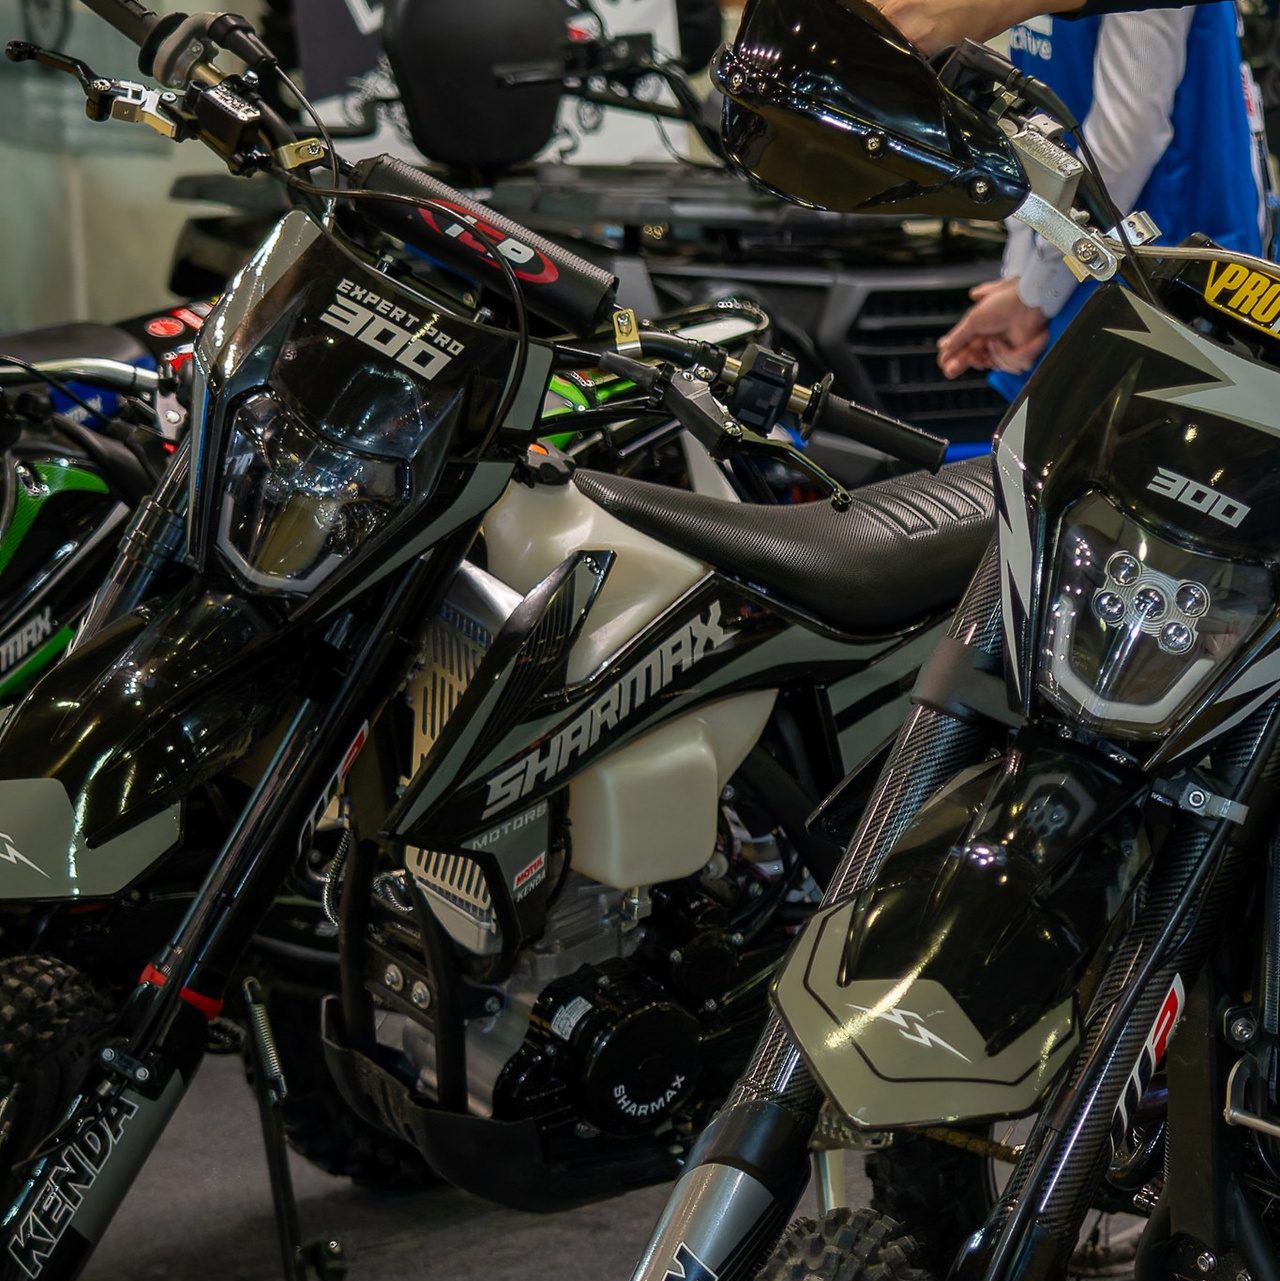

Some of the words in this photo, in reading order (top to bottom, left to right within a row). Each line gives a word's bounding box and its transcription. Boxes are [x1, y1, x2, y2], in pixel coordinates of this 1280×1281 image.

[336, 278, 420, 328] EXPERT
[319, 293, 452, 381] 300
[1146, 466, 1251, 528] 300
[481, 599, 742, 821] SHARMAX
[472, 802, 547, 851] MOTORS
[517, 869, 547, 903] KENDA
[613, 1074, 686, 1117] SHARMAX
[8, 1095, 139, 1280] KENDA
